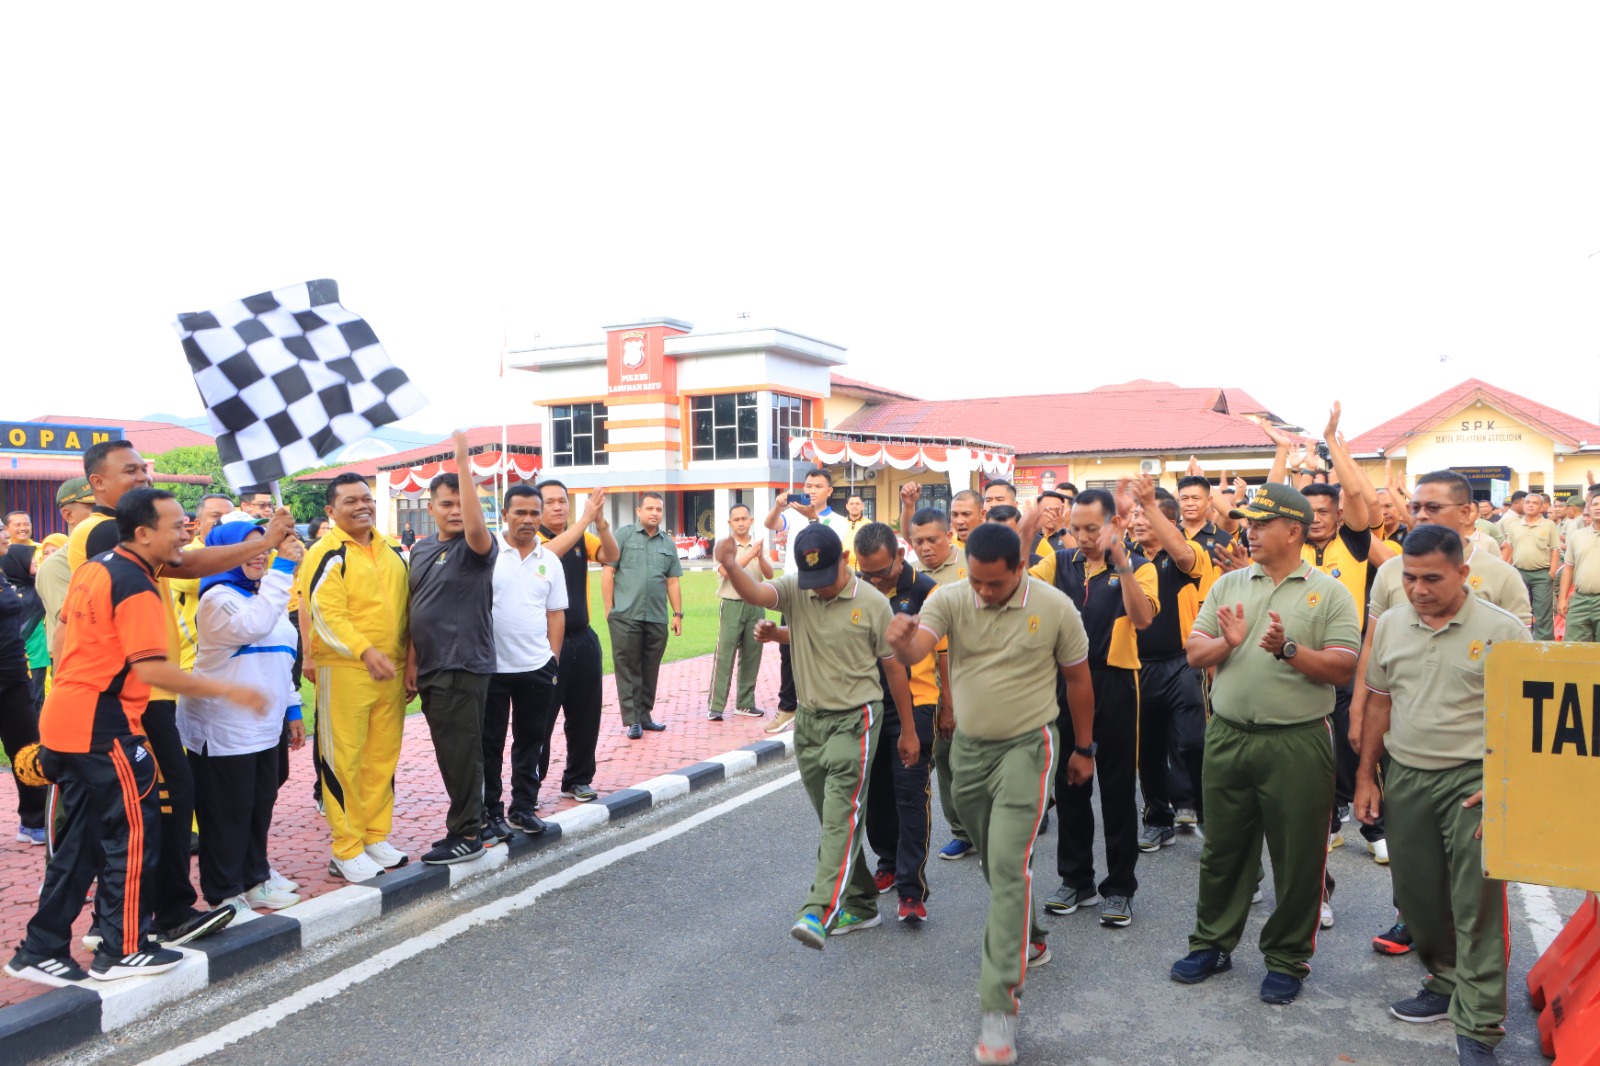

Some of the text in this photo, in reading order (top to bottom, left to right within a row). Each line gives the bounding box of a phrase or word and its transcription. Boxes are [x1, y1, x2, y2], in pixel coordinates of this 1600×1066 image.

[621, 373, 648, 382] POLRES
[1461, 420, 1496, 431] SPK
[0, 428, 109, 449] OPAM
